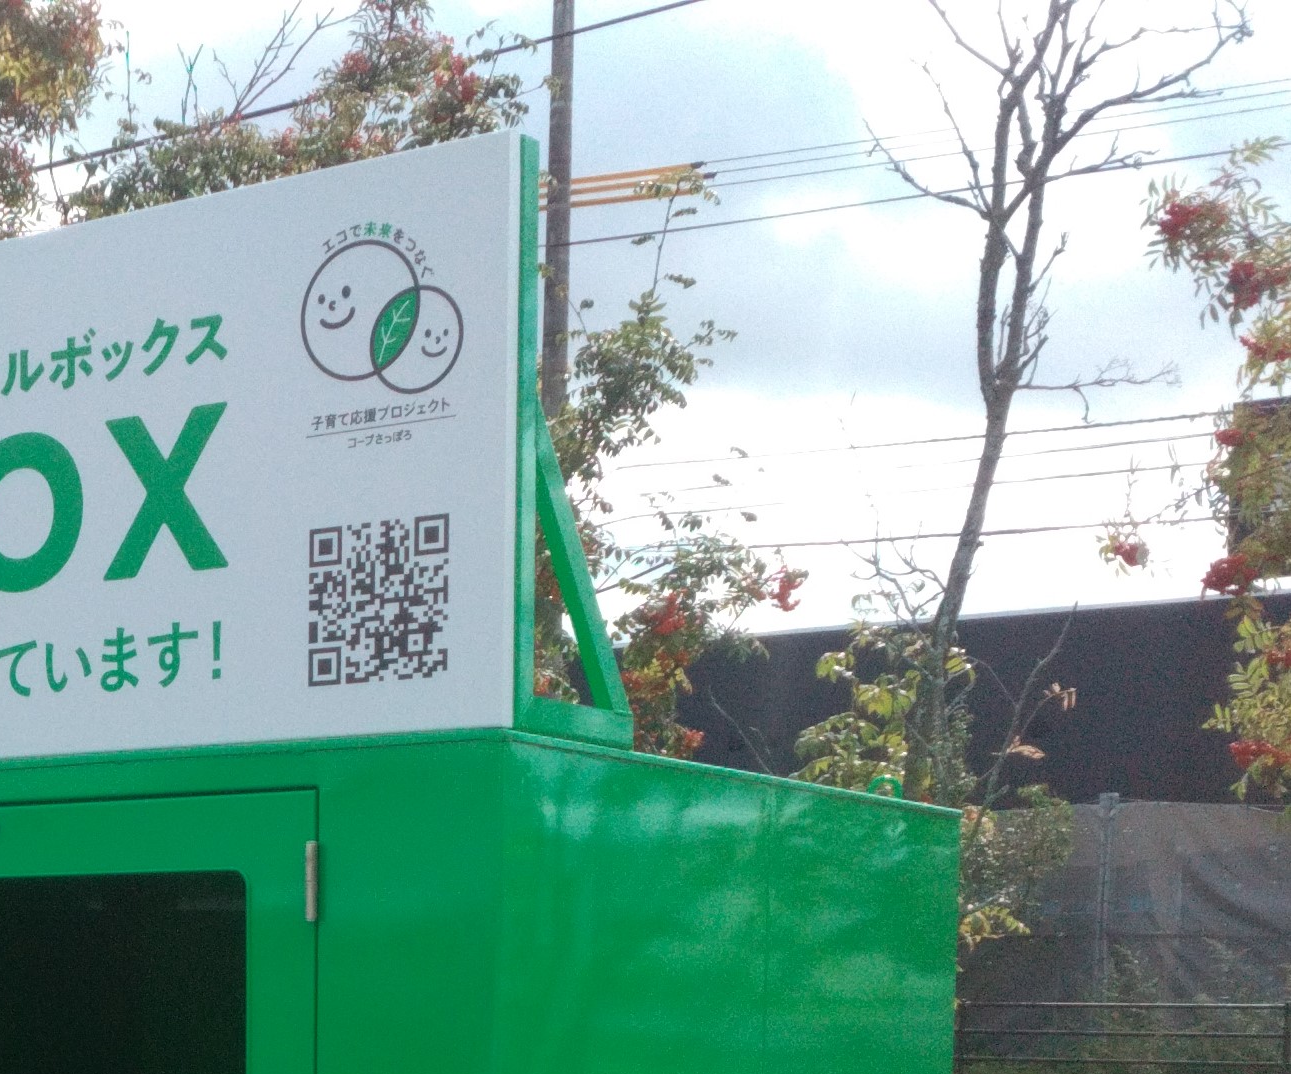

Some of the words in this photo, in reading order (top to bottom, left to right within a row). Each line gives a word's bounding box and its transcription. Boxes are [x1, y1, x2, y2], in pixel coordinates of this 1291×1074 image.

[311, 397, 451, 431] 子育て応援プロジェクト
[347, 429, 413, 449] コープさっぽろ
